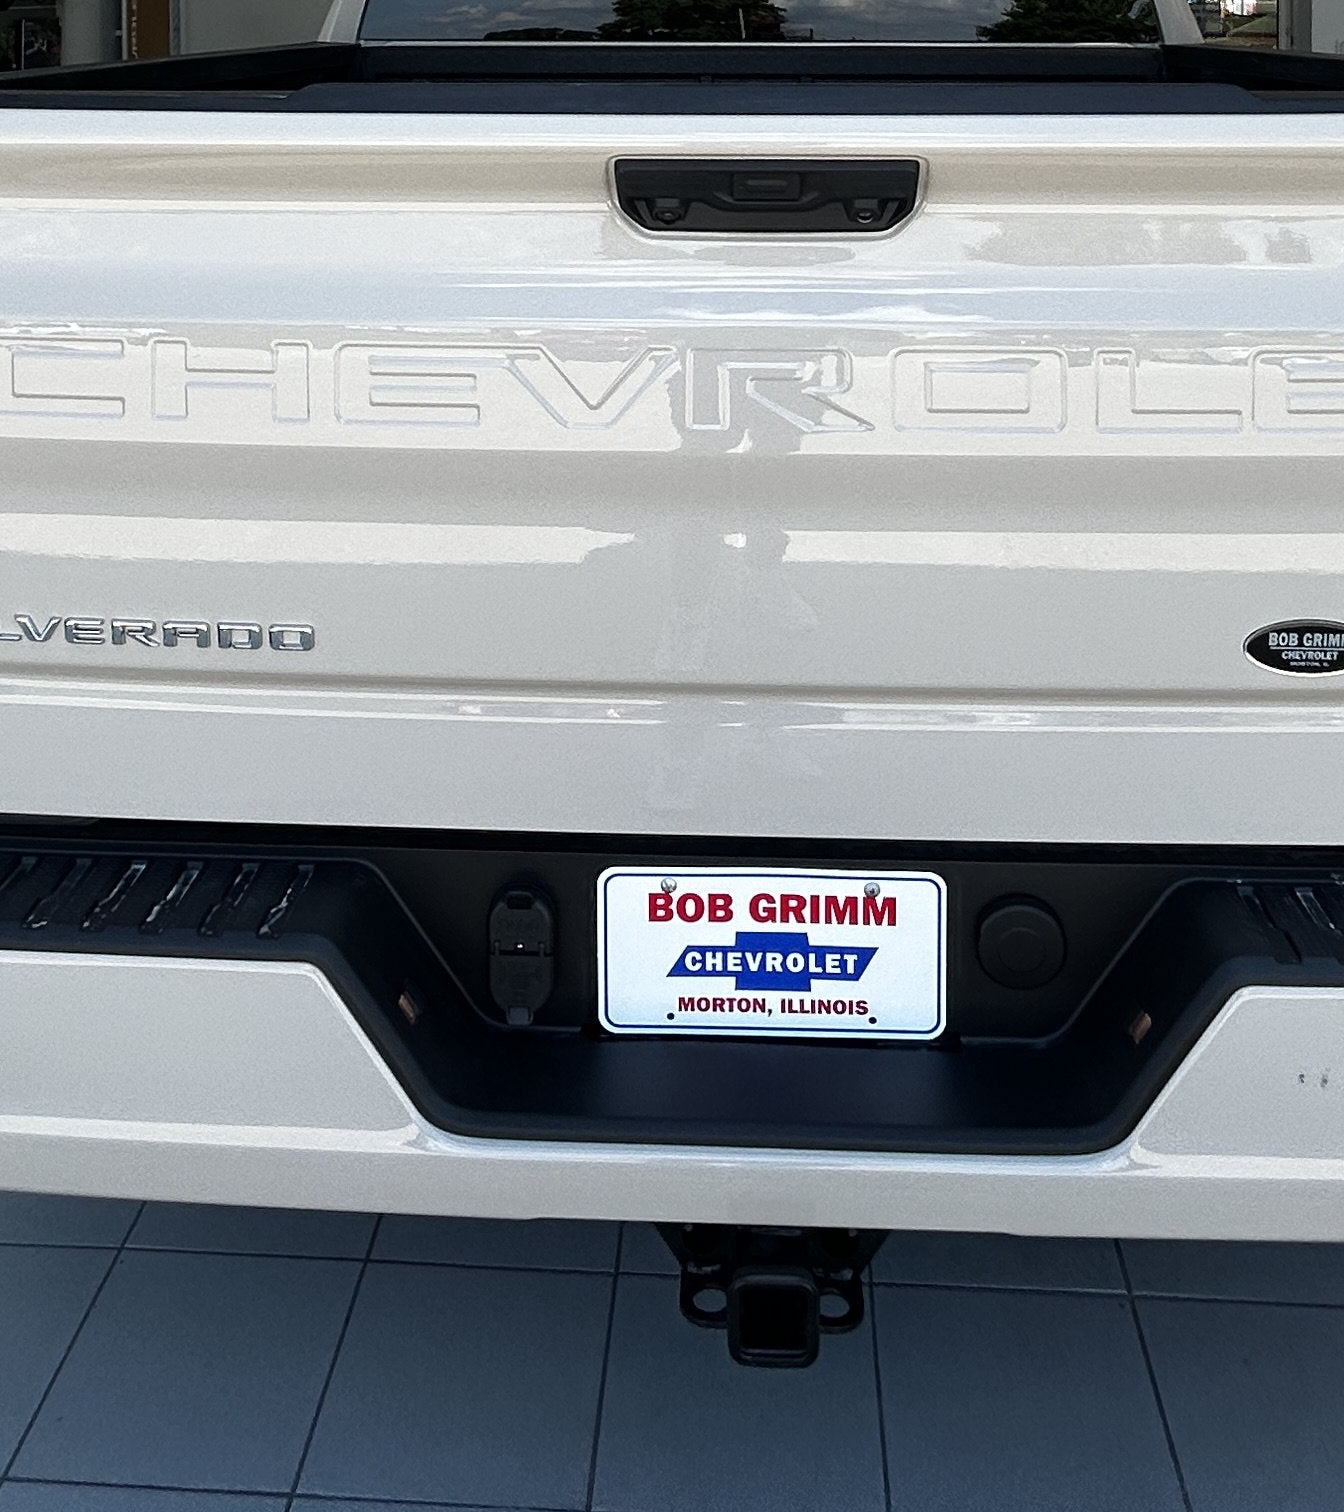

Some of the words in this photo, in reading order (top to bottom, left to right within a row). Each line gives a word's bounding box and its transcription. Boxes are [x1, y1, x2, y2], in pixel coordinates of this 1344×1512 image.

[1268, 631, 1298, 647] BOB
[1281, 650, 1339, 661] CHEVROLET
[647, 891, 733, 923] BOB
[748, 892, 897, 927] GRIMM
[683, 949, 859, 975] CHEVROLET
[677, 996, 773, 1018] MORTON,
[780, 998, 869, 1016] ILLINOIS
